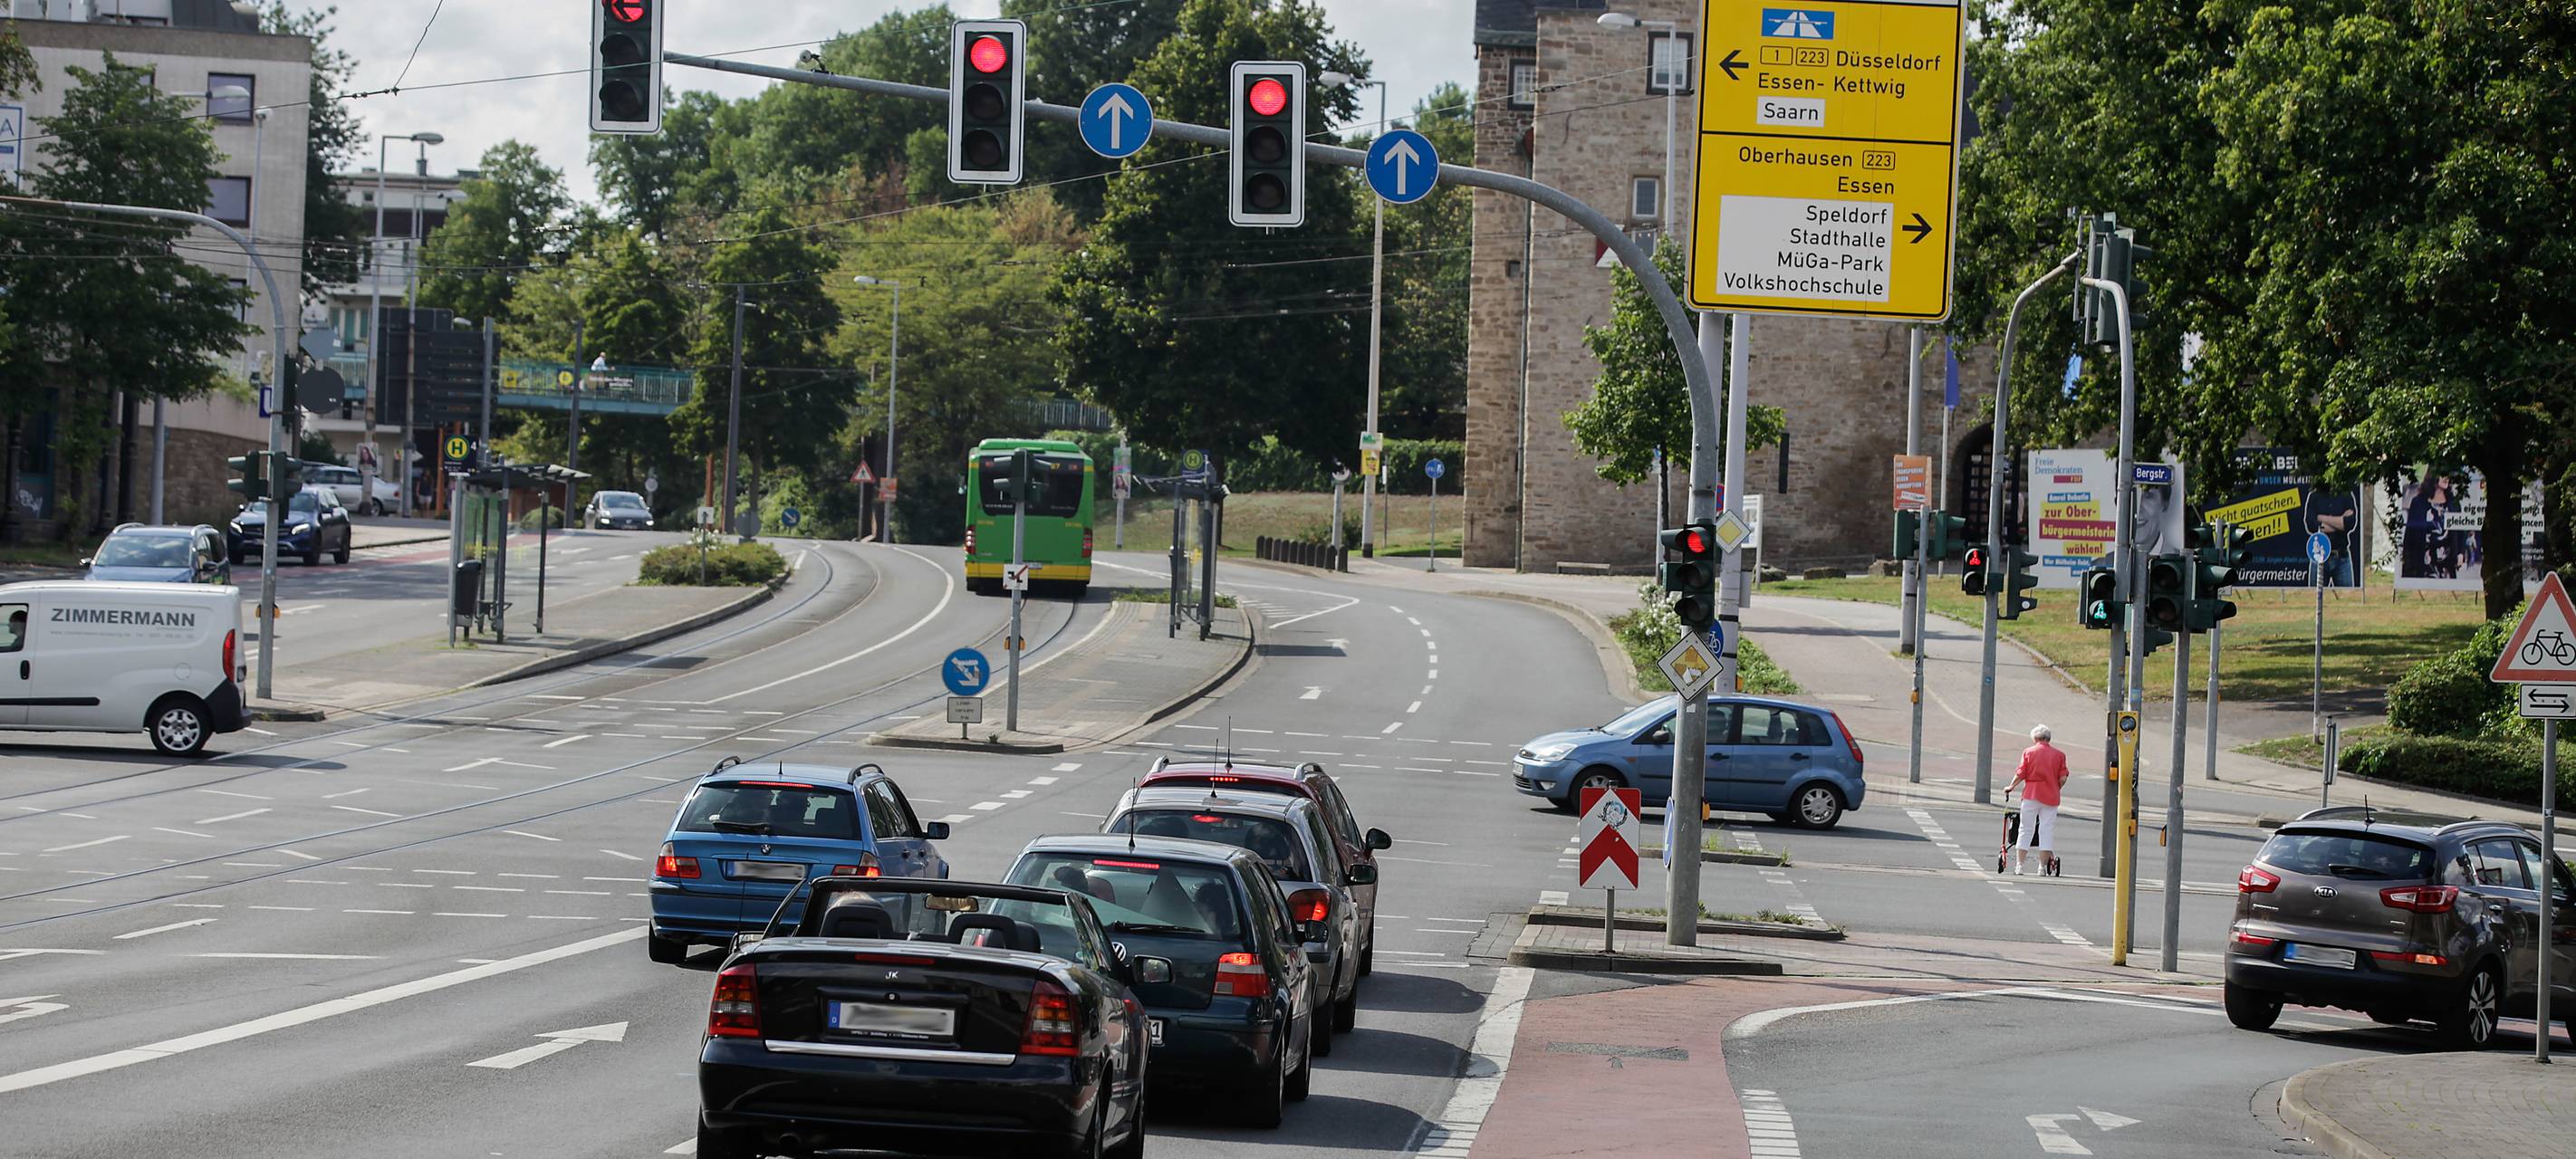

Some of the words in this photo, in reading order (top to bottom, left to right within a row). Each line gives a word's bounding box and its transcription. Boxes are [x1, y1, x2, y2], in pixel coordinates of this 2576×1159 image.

[1774, 50, 1780, 62] 1
[1799, 50, 1825, 64] 223
[1836, 51, 1941, 72] Düsseldorf
[1758, 73, 1824, 91] Essen-
[1833, 76, 1906, 99] Kettwig
[1764, 103, 1819, 120] Saarn
[1739, 147, 1853, 168] Oberhausen
[1866, 154, 1891, 168] 223
[1838, 177, 1895, 195] Essen
[1806, 206, 1887, 225] Speldorf
[1790, 228, 1886, 248] Stadthalle
[1777, 251, 1884, 272] MüGa-Park
[1725, 273, 1883, 296] Volkshochschule
[2034, 465, 2083, 474] Demokraten
[2035, 457, 2054, 465] Freie
[2136, 468, 2167, 482] Bergstr.
[2044, 508, 2062, 518] zur
[2066, 504, 2097, 518] Ober-
[2241, 494, 2296, 519] quatschen,
[2446, 517, 2475, 529] gleiche
[2066, 543, 2103, 554] wählen!
[51, 608, 196, 627] ZIMMERMANN
[2317, 888, 2333, 896] KIA
[885, 971, 899, 980] JK
